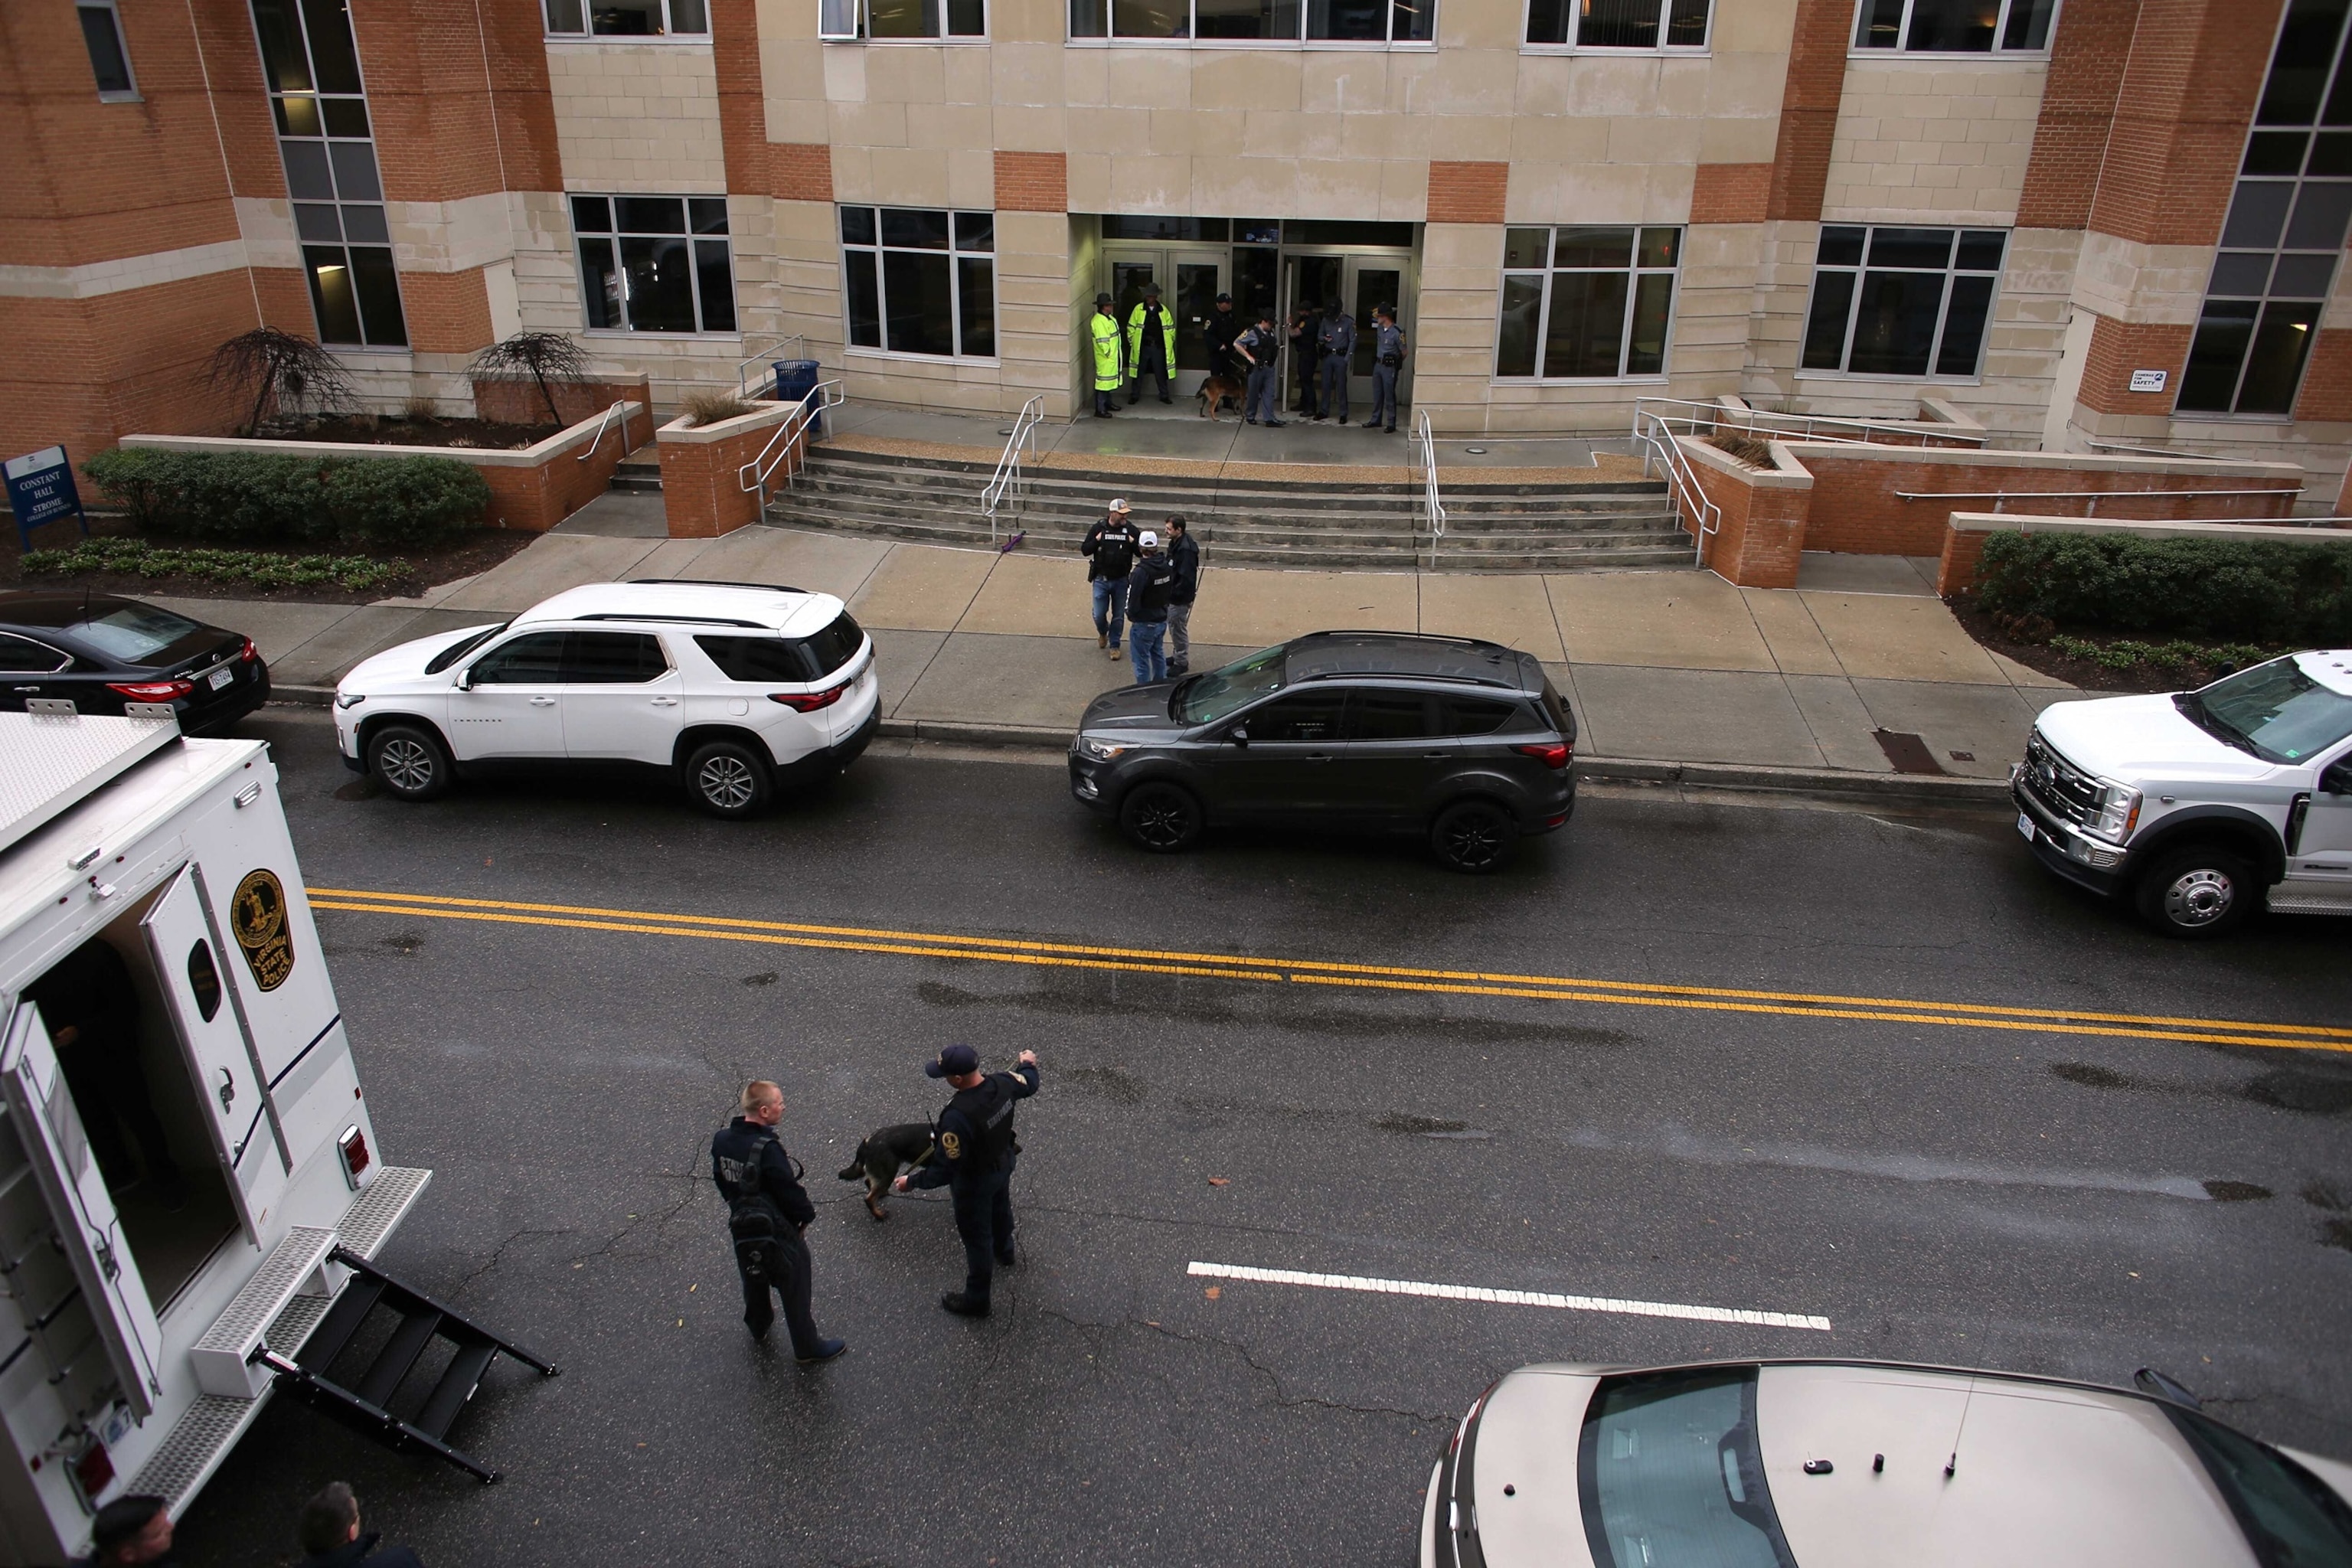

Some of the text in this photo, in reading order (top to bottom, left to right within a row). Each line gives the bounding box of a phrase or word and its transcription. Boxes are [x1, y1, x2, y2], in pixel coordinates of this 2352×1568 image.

[19, 470, 60, 491] CONSTANT
[34, 486, 54, 499] HALL
[32, 497, 63, 514] STROME
[253, 934, 287, 968] VIRGINIA
[260, 947, 286, 975] STATE
[263, 956, 291, 985] POLICE
